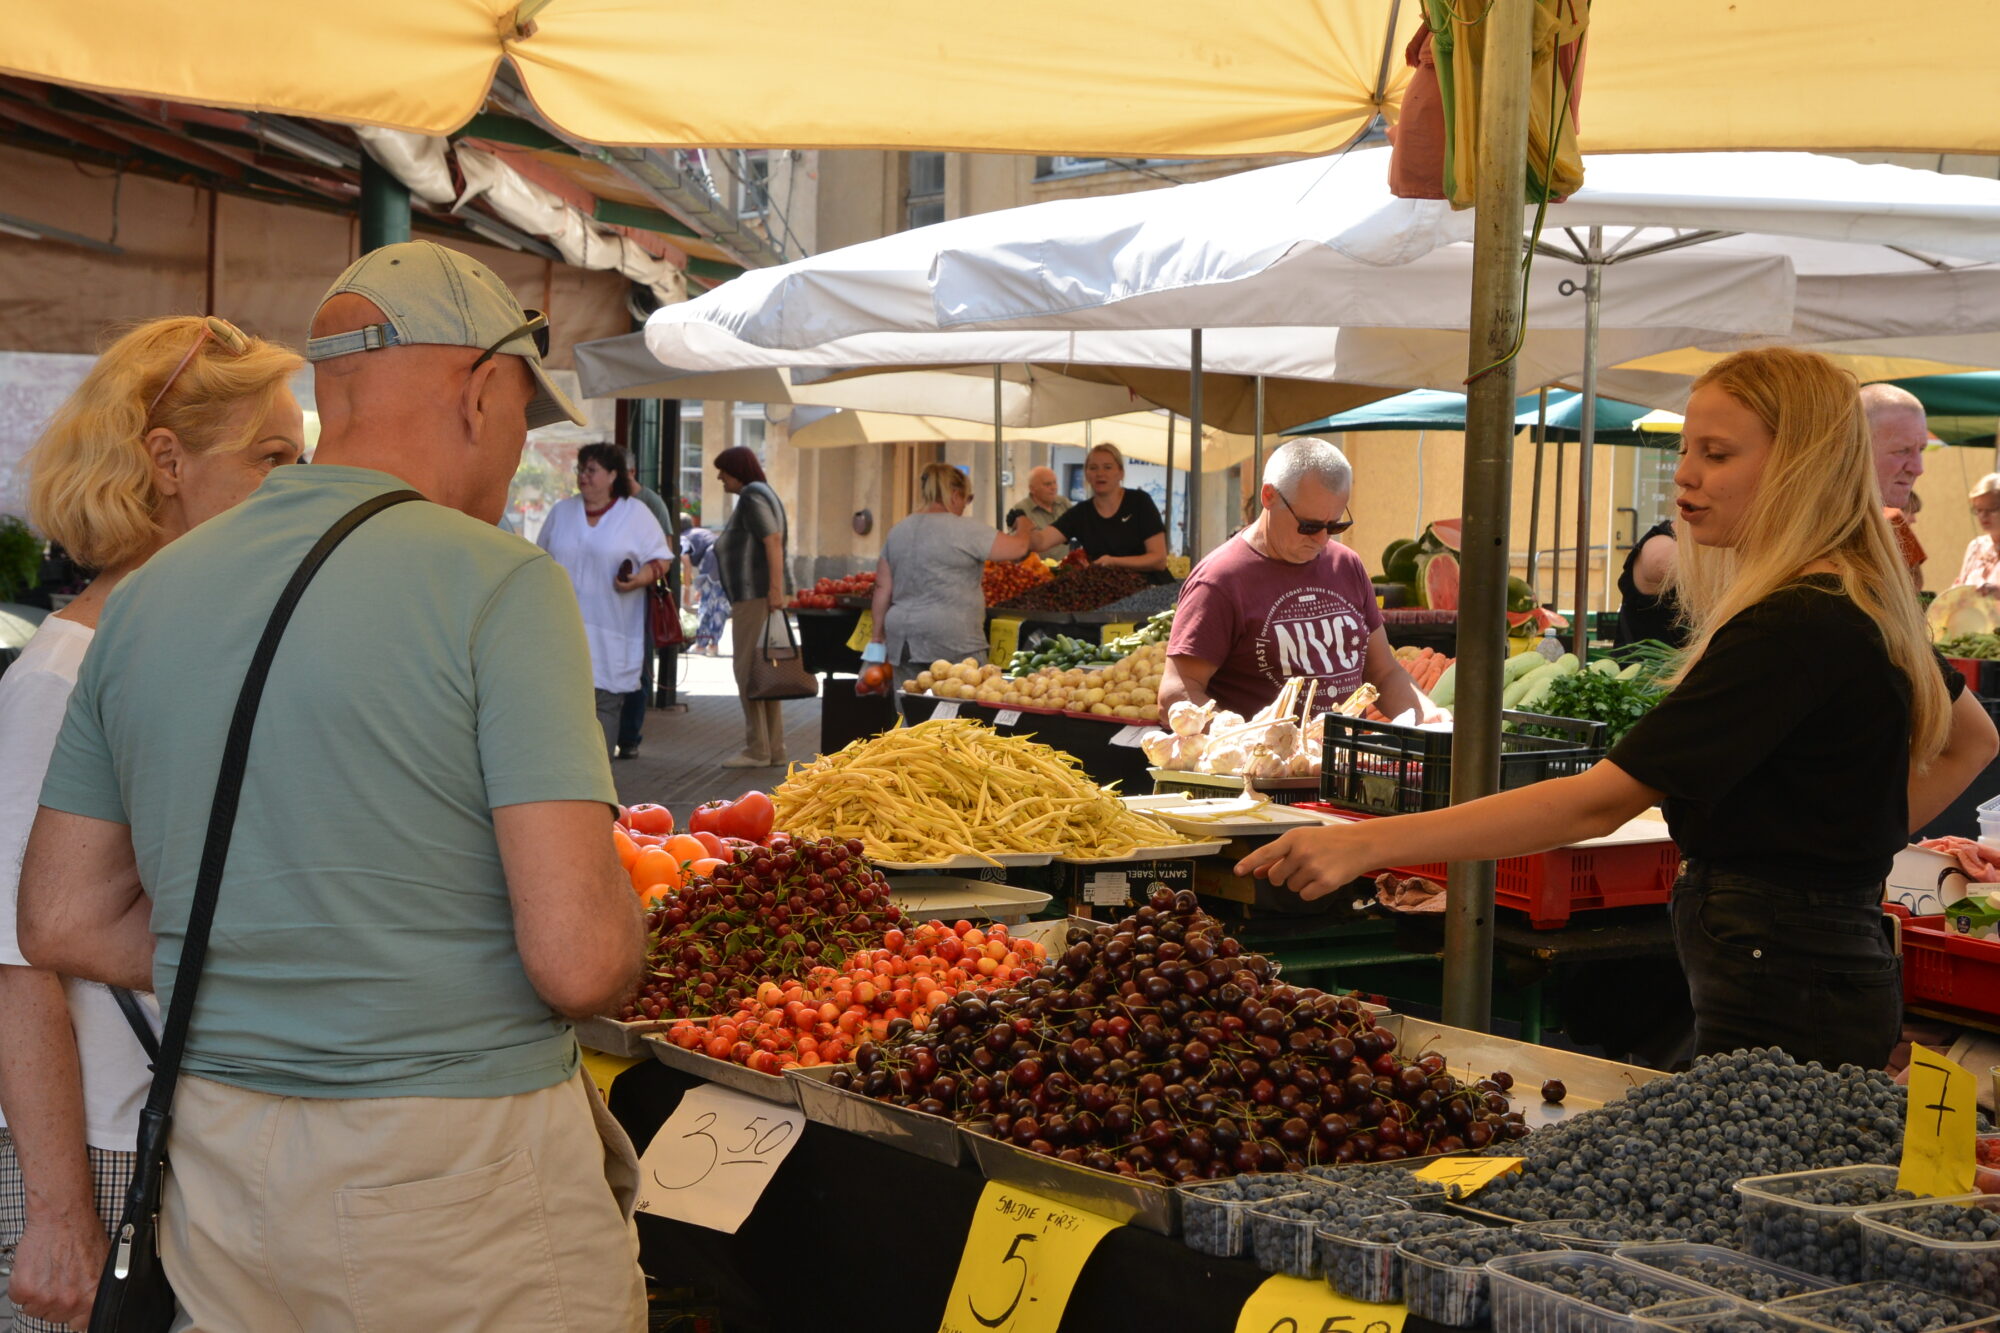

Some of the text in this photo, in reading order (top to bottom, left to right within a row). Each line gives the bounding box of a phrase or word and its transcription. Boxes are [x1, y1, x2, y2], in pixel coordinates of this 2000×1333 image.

[1285, 587, 1303, 598] COAST
[1256, 642, 1267, 668] EAST
[1274, 615, 1359, 676] NYC
[1158, 870, 1188, 878] SANTA
[1914, 1061, 1957, 1137] 7
